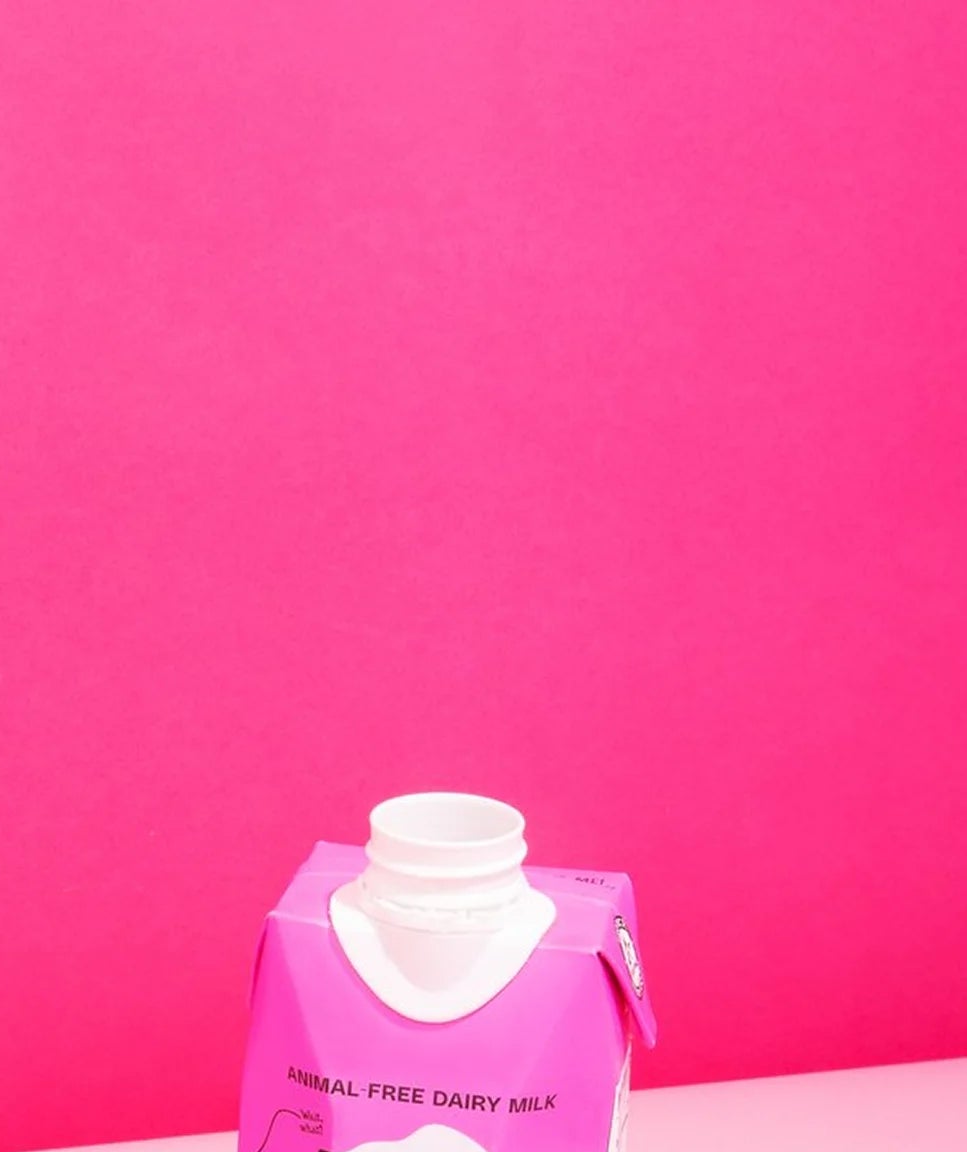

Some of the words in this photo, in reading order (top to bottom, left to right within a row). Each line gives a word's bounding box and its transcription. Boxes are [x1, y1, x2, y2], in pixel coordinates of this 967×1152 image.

[287, 1066, 425, 1104] ANIMAL-FREE
[433, 1090, 501, 1112] DAIRY
[509, 1094, 557, 1113] MILK
